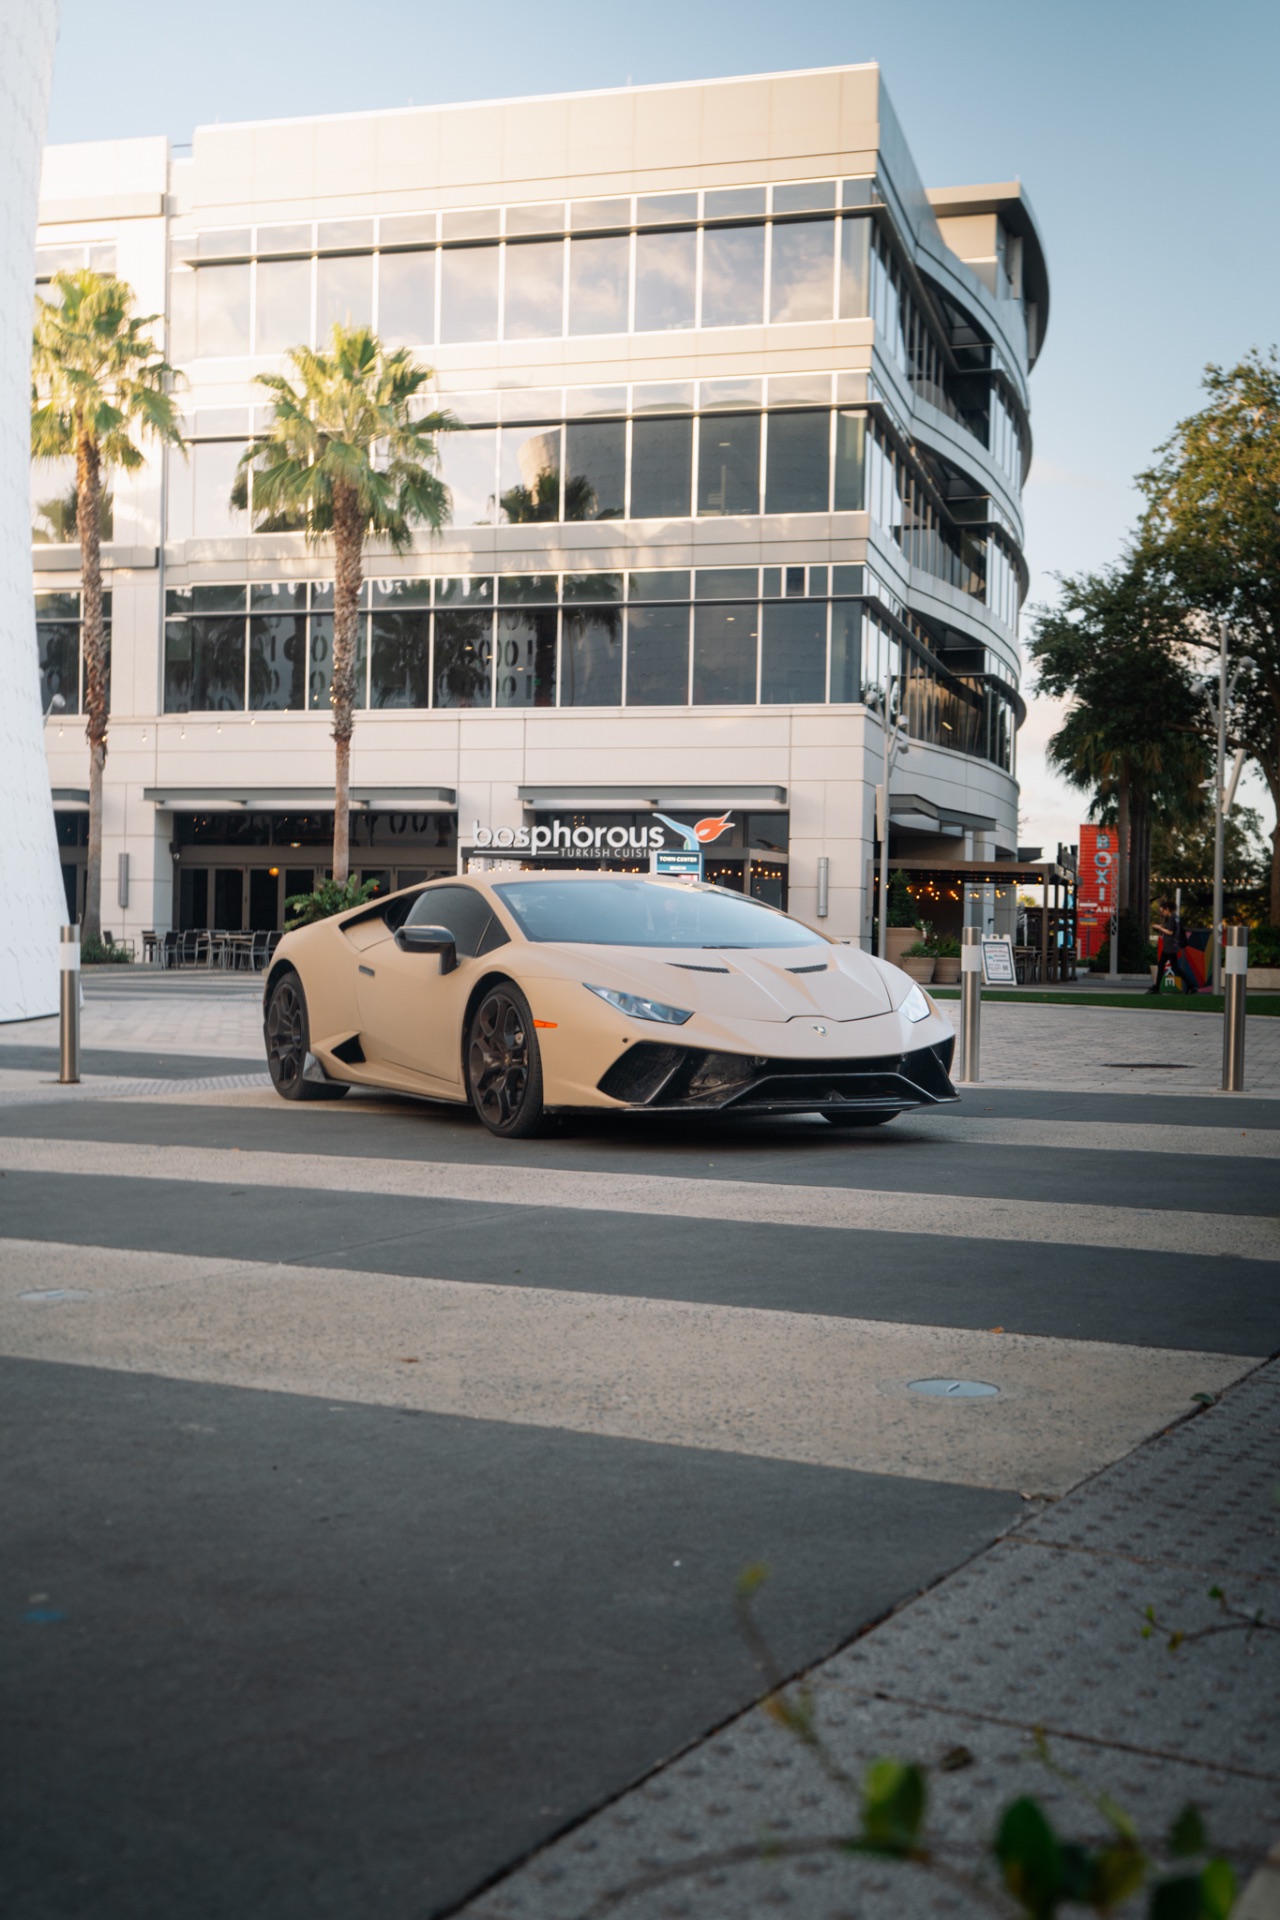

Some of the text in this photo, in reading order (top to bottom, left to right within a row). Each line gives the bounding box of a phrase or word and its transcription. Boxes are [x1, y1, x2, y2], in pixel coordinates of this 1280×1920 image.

[472, 819, 665, 856] bosphorous
[560, 847, 663, 858] TURKISH CUISI
[1093, 834, 1112, 902] BOXI
